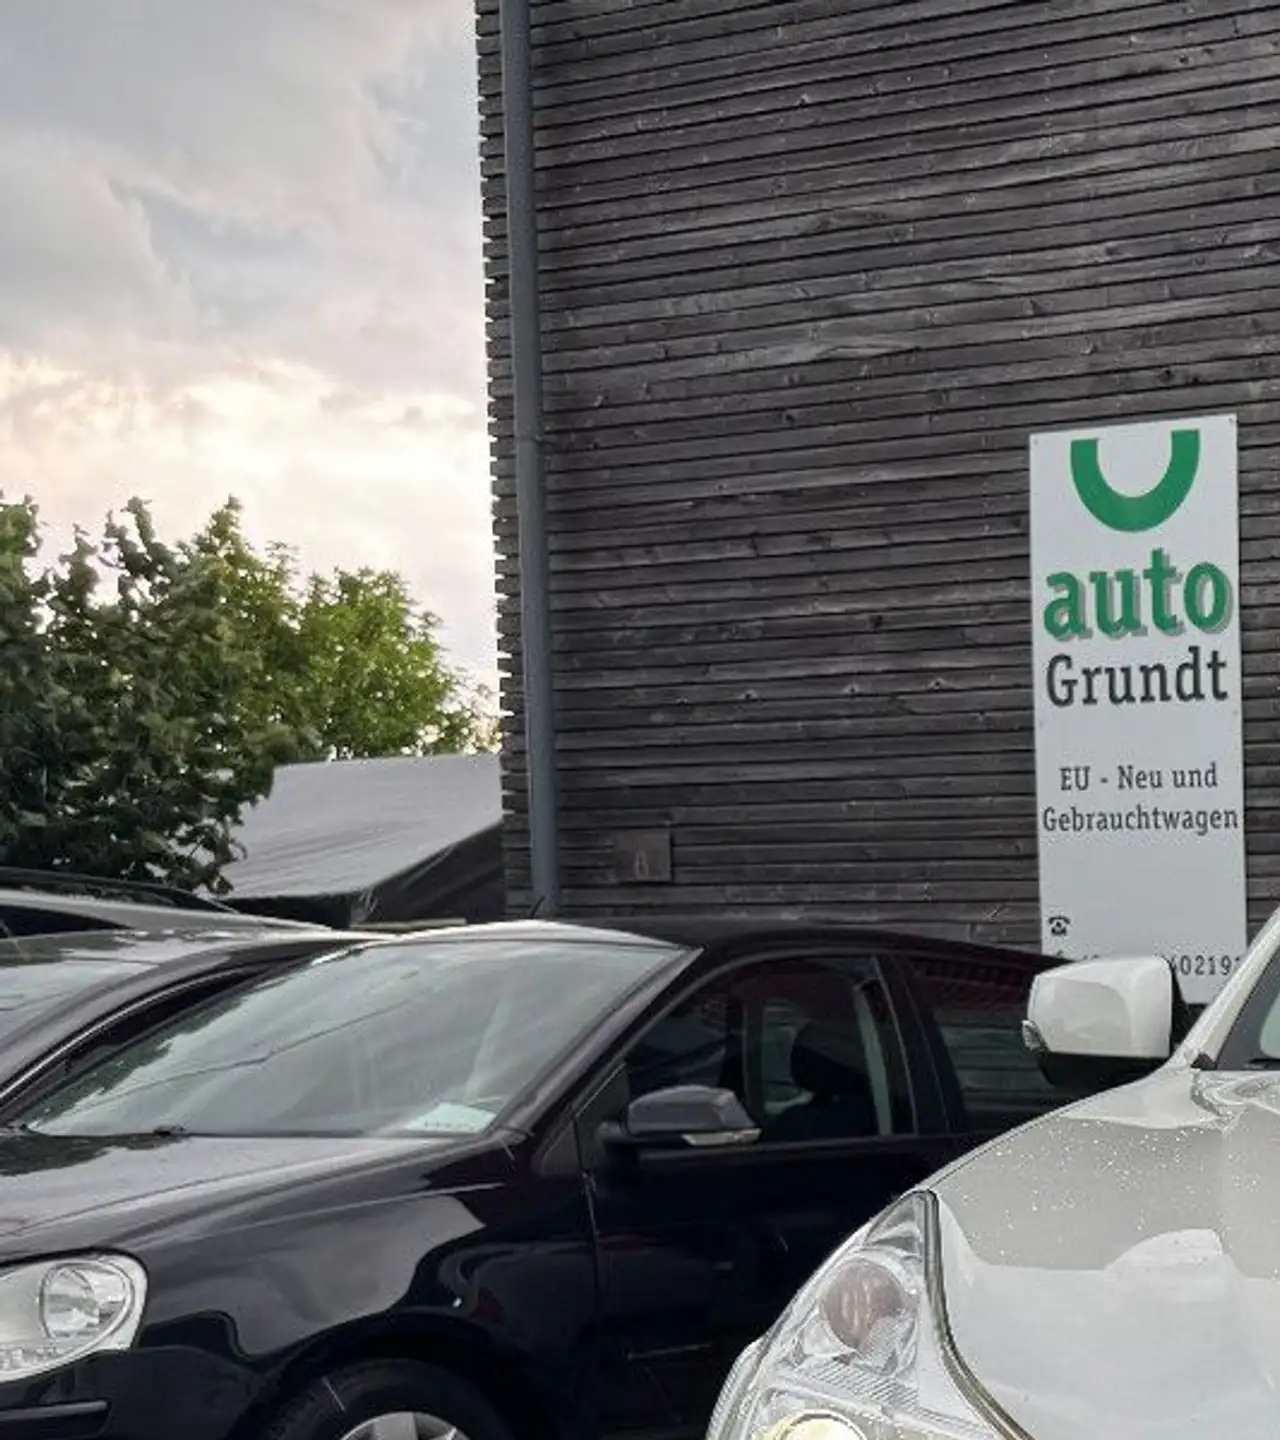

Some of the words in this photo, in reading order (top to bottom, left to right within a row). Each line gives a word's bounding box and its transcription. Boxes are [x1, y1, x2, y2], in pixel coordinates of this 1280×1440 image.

[1043, 547, 1232, 642] auto
[1046, 645, 1228, 708] Grundt
[1060, 765, 1090, 792] EU
[1117, 764, 1163, 790] Neu
[1172, 761, 1218, 789] und
[1043, 804, 1238, 836] Gebrauchtwagen
